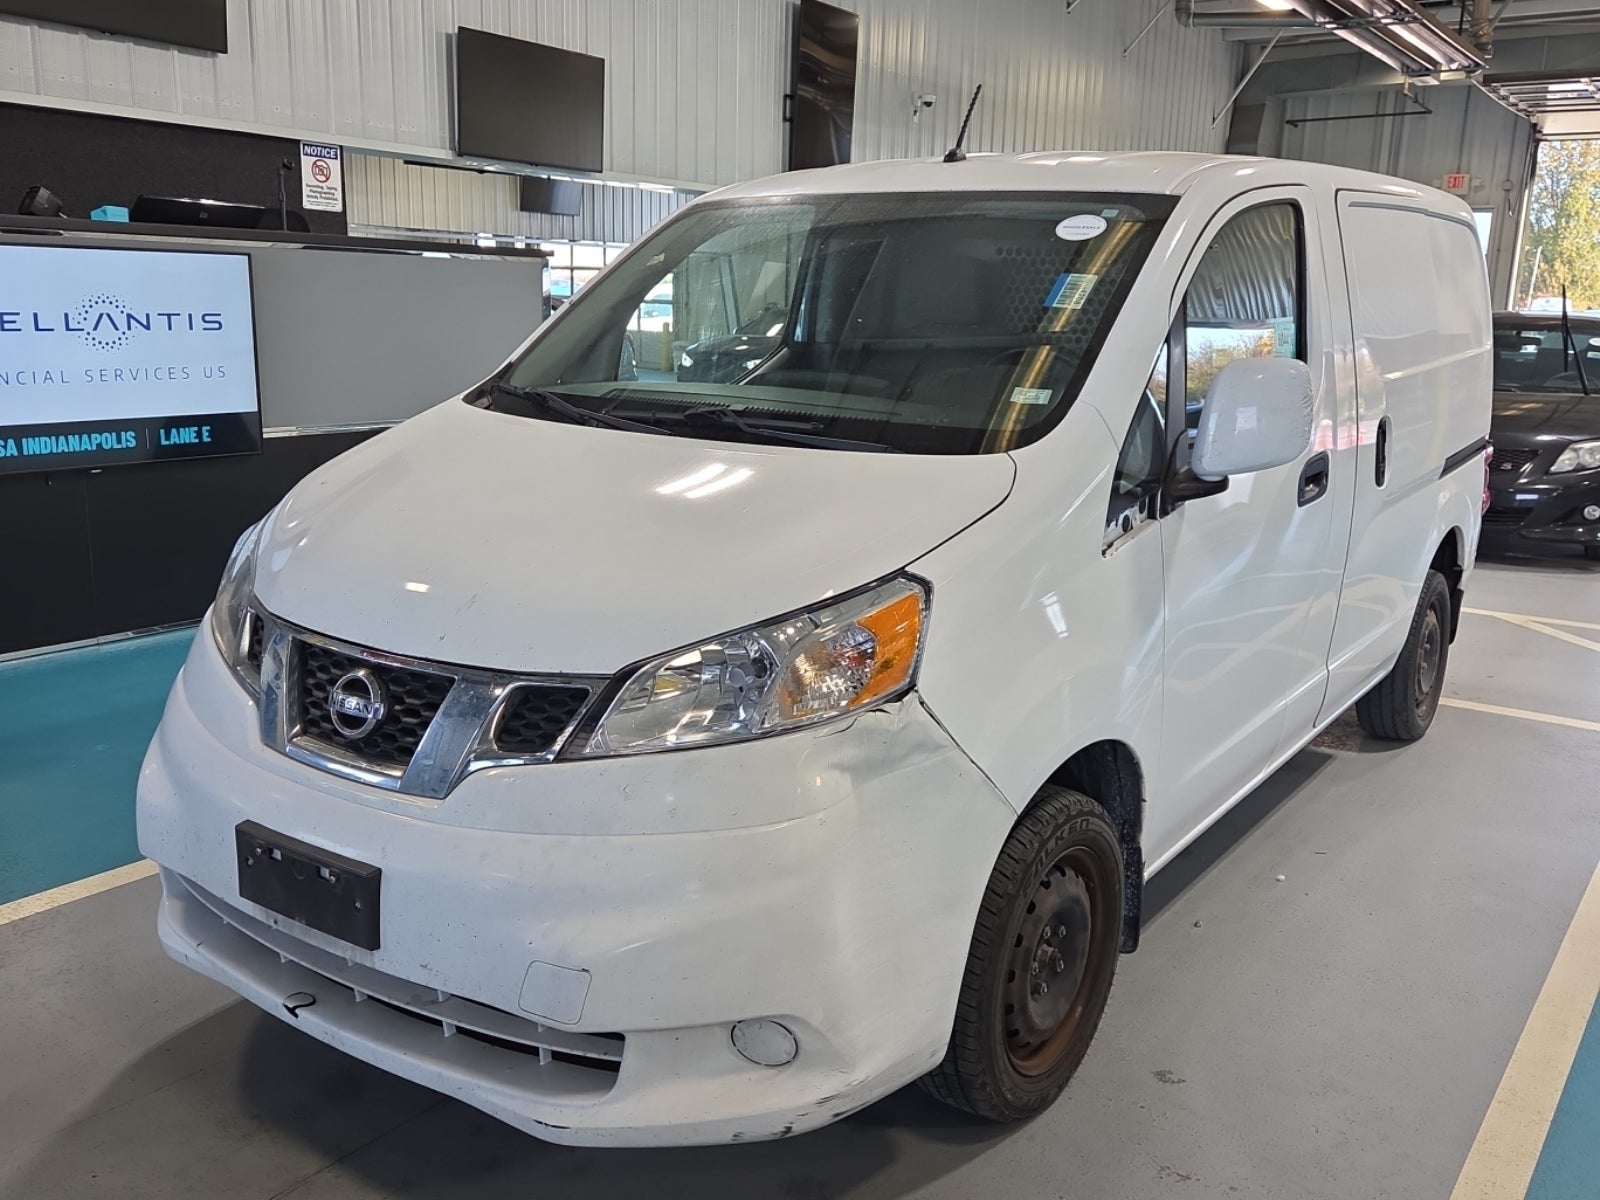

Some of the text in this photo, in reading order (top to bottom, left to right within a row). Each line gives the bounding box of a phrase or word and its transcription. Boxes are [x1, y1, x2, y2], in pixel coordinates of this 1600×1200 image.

[303, 145, 337, 158] NOTICE
[0, 312, 223, 331] ELLANTIS
[84, 366, 190, 383] SERVICES
[203, 366, 226, 379] US
[22, 431, 136, 456] INDIANAPOLIS
[160, 426, 199, 445] LANE
[202, 426, 212, 442] E
[330, 694, 373, 715] NISSAN
